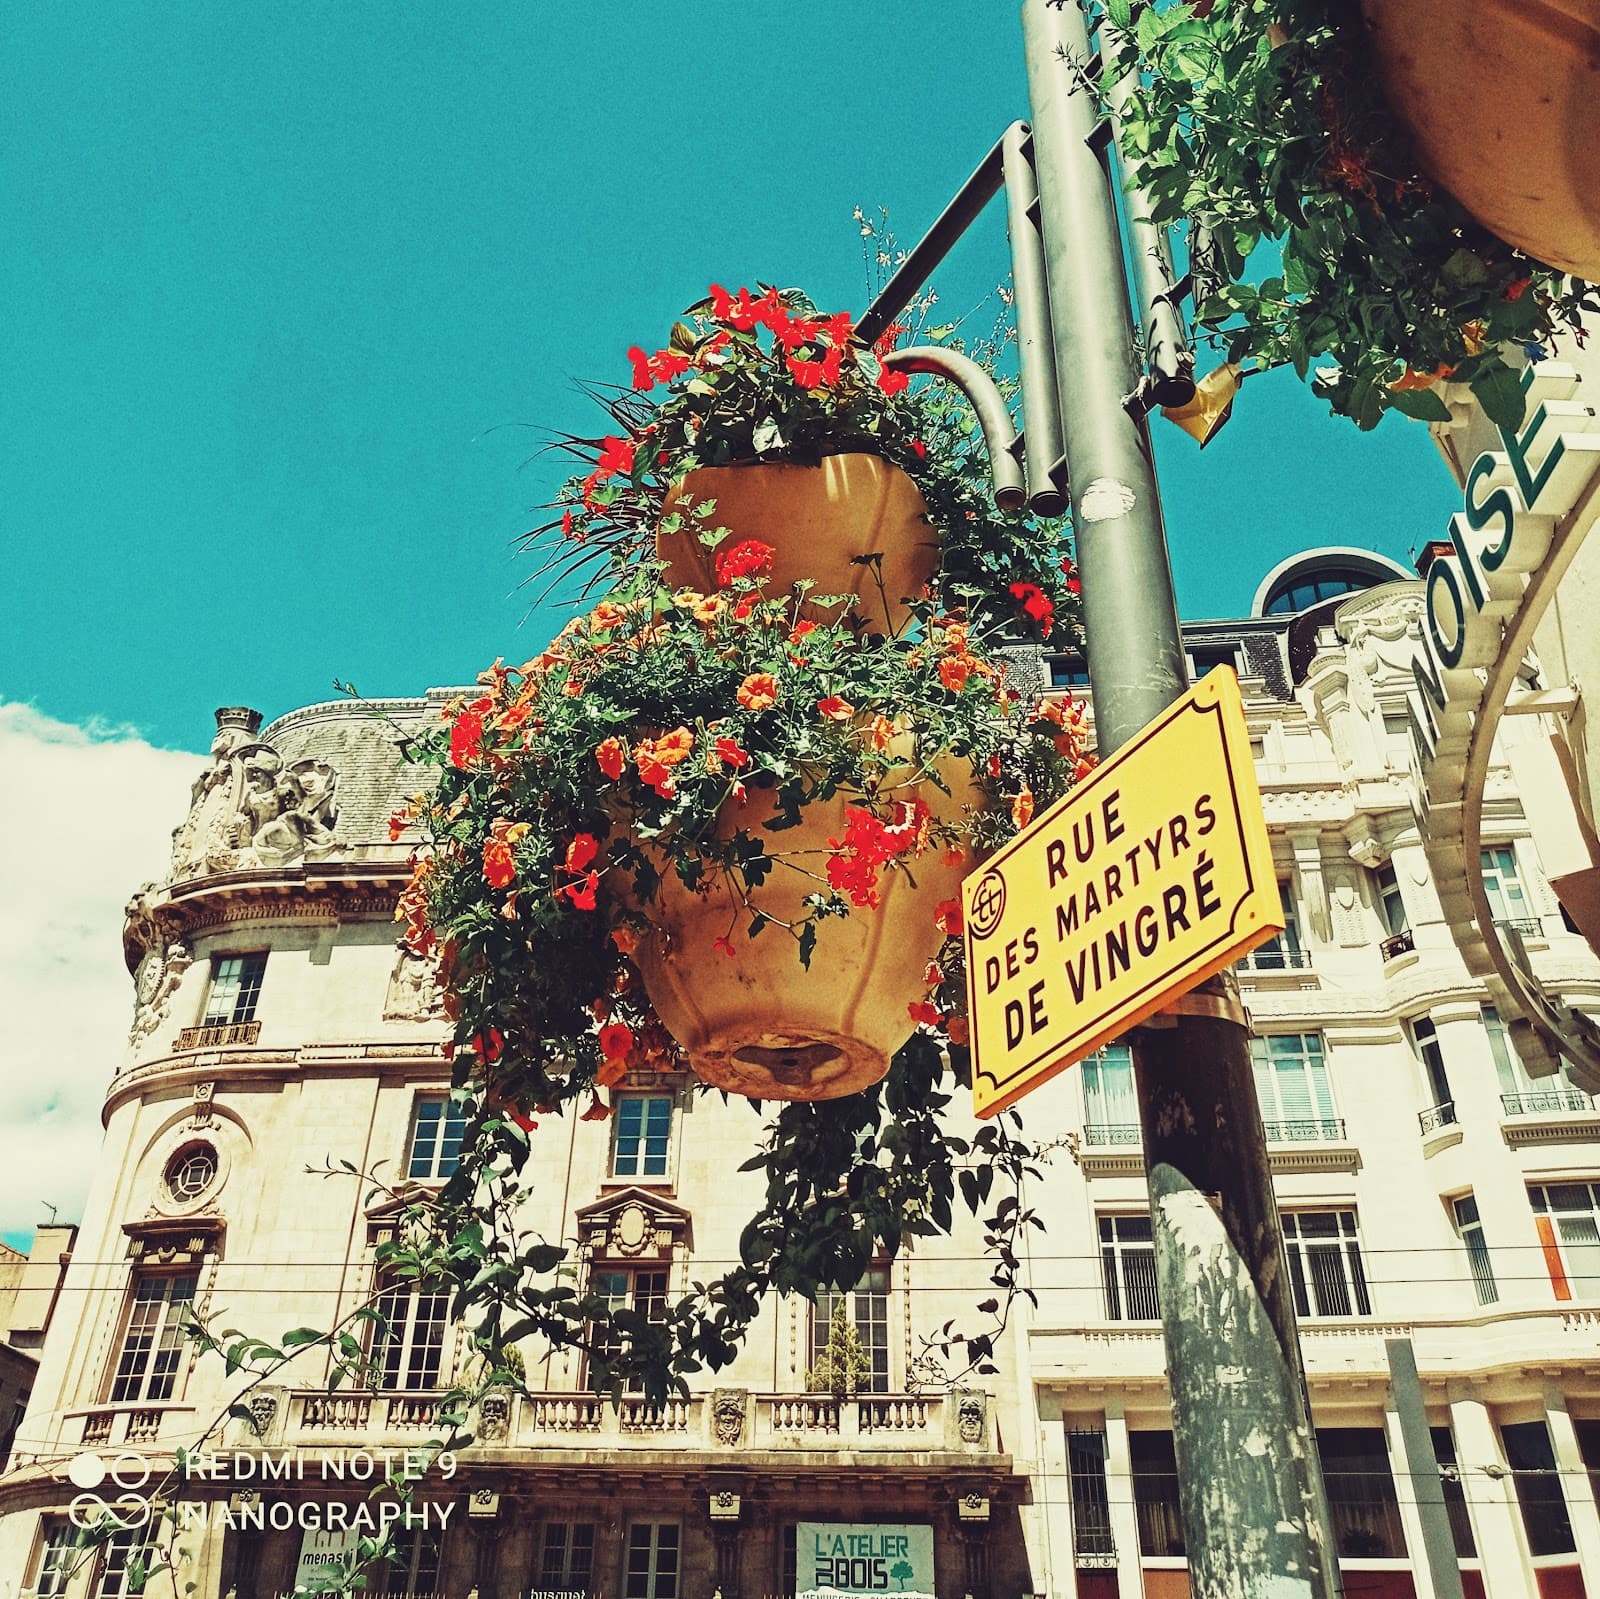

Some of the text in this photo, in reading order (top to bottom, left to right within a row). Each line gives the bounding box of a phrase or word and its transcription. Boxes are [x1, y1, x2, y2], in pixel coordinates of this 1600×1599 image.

[1047, 789, 1125, 888] RUE
[985, 927, 1039, 994] DES
[1056, 794, 1216, 942] MARTYRS
[1005, 980, 1049, 1051] DE
[1066, 849, 1221, 1004] VINGRÉ
[815, 1533, 908, 1558] L'ATELIER
[834, 1558, 888, 1589] BOIS
